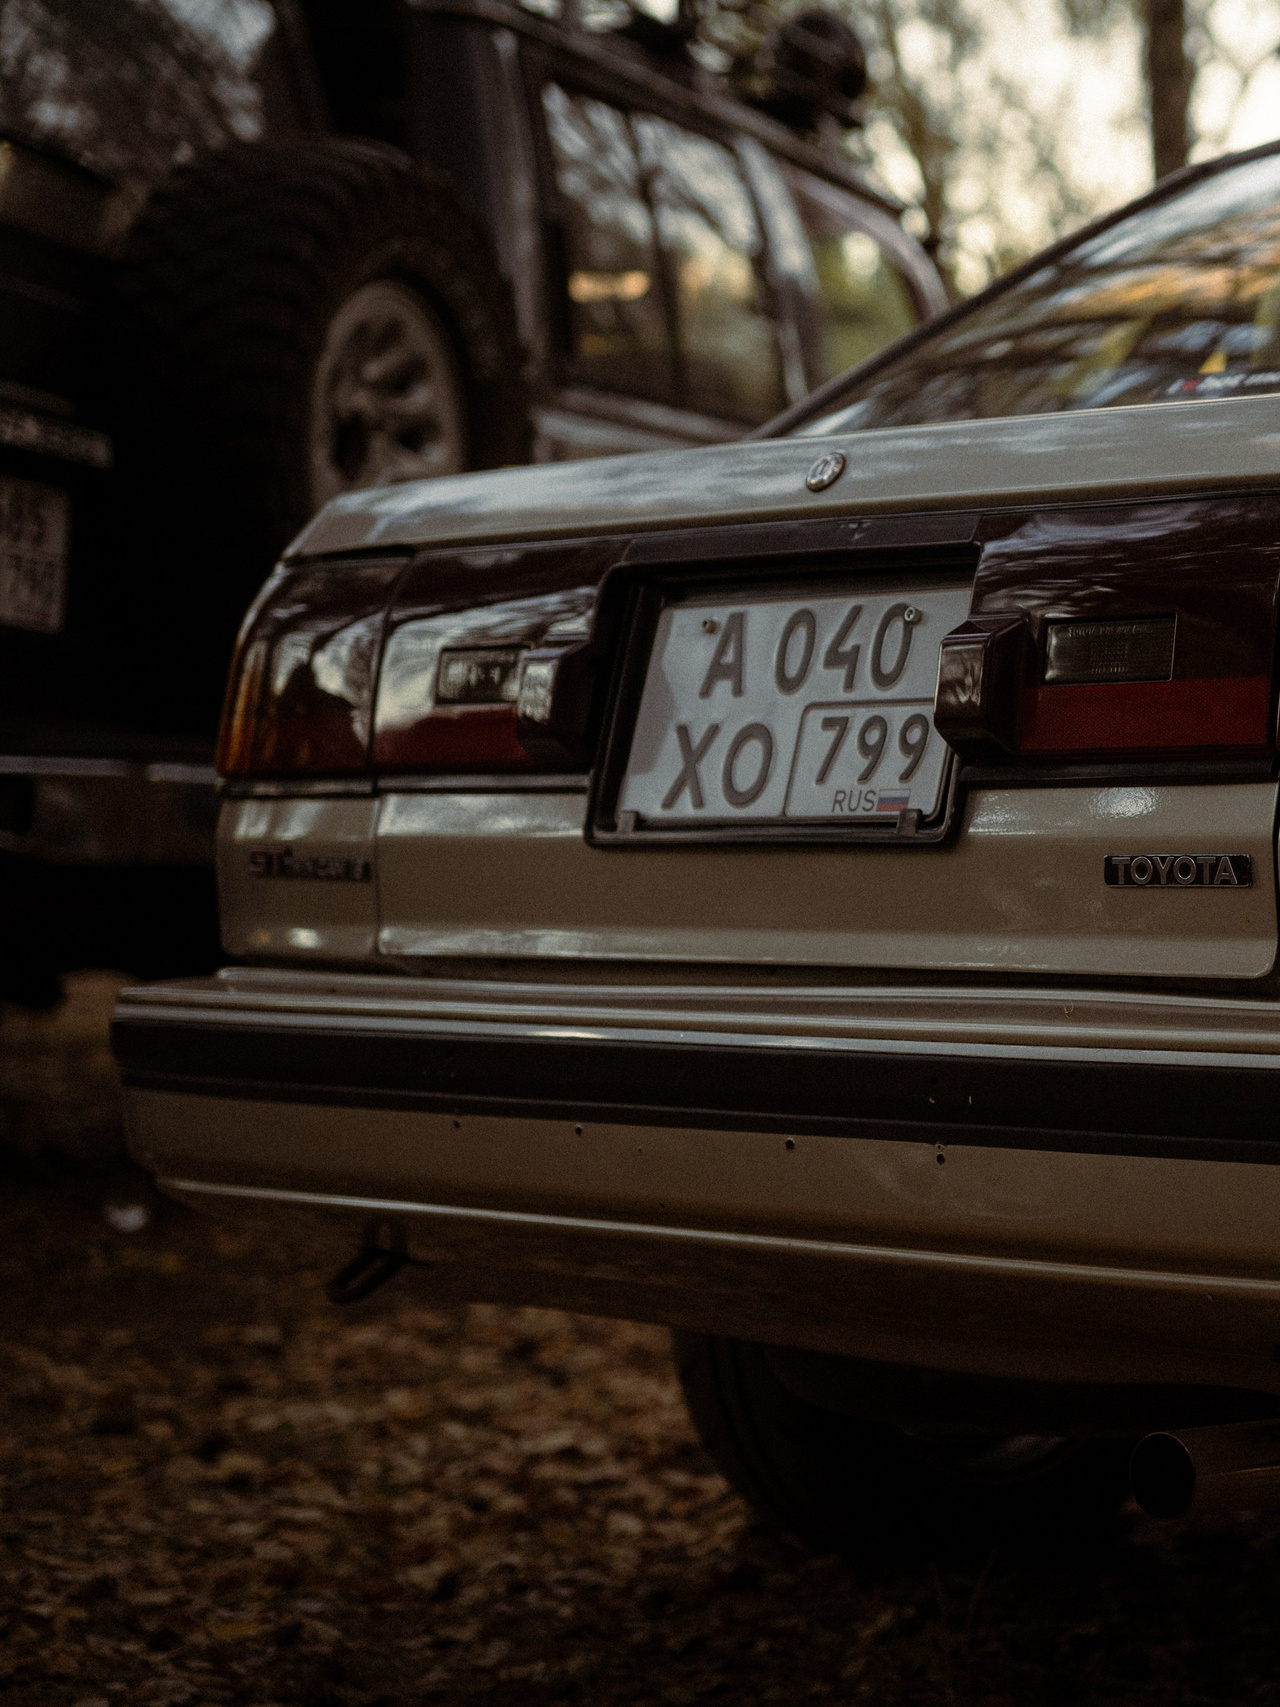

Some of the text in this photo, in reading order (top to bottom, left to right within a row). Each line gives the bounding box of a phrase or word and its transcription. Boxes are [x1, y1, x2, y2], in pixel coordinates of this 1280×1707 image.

[700, 603, 915, 698] A 040
[662, 713, 931, 809] XO 799
[832, 789, 877, 813] RUS
[1112, 856, 1239, 886] TOYOTA
